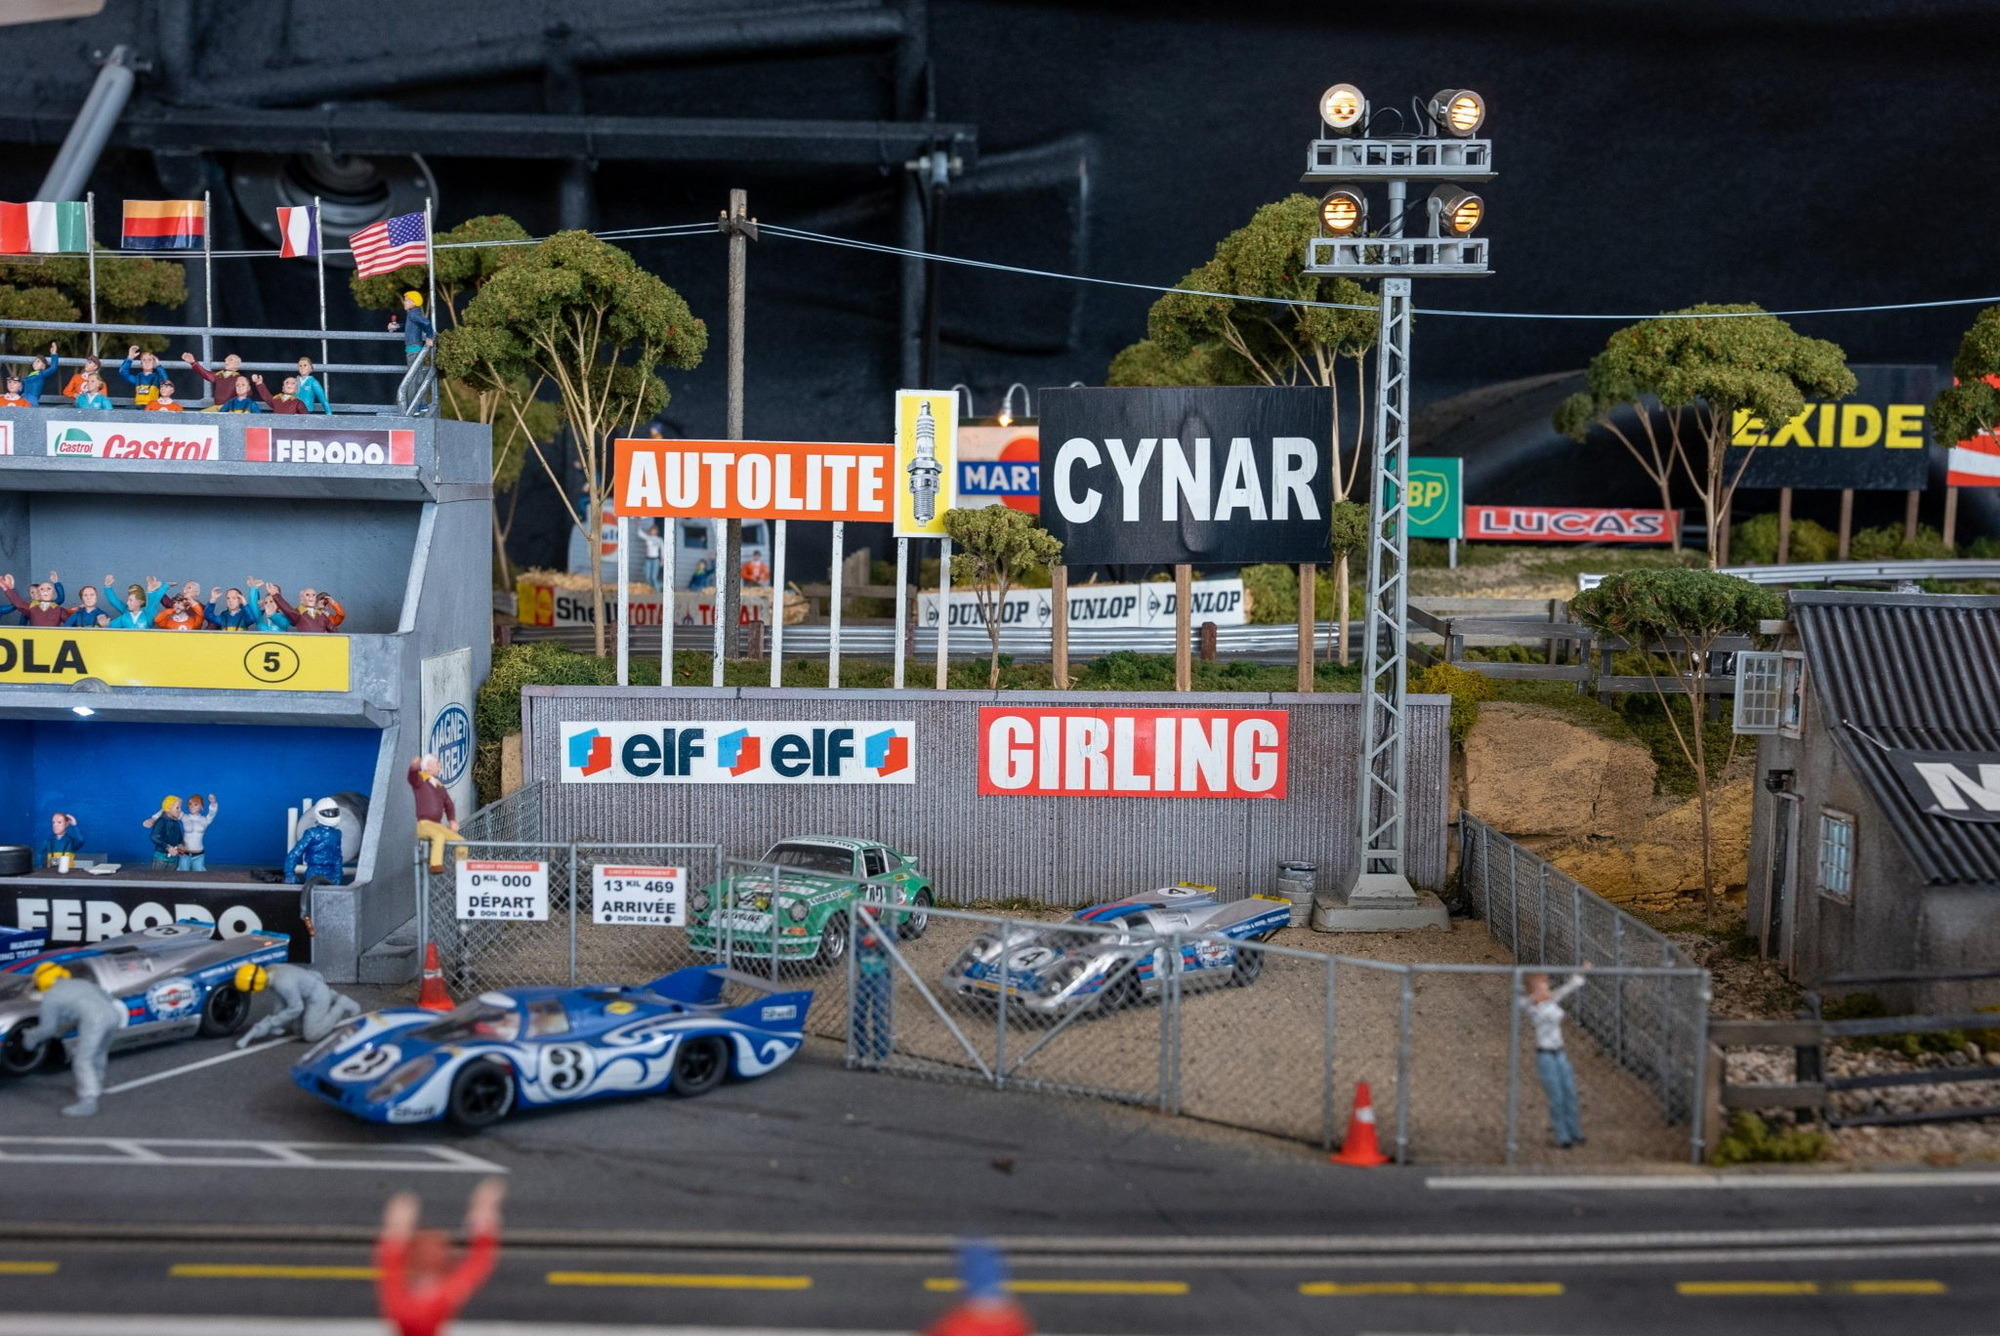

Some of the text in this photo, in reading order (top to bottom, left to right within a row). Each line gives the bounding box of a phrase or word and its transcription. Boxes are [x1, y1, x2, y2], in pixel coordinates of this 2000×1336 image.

[1731, 403, 1925, 448] EXIDE
[59, 442, 93, 453] Castrol
[103, 434, 212, 460] Castrol
[276, 439, 384, 464] FERODO
[625, 451, 884, 512] AUTOLITE
[1053, 437, 1321, 523] CYNAR
[1407, 481, 1442, 507] BP
[1480, 511, 1663, 535] LUCAS
[1066, 596, 1136, 620] UNLOP
[1164, 591, 1240, 614] DNLOP
[263, 652, 280, 672] 5
[622, 728, 854, 777] elf elf
[989, 716, 1279, 792] GIRLING
[472, 875, 481, 886] 0
[502, 875, 531, 887] 000
[604, 880, 623, 892] 13
[644, 881, 674, 893] 469
[469, 892, 534, 908] DÉPART
[602, 898, 676, 914] ARRIVÉE
[550, 1049, 584, 1090] 3
